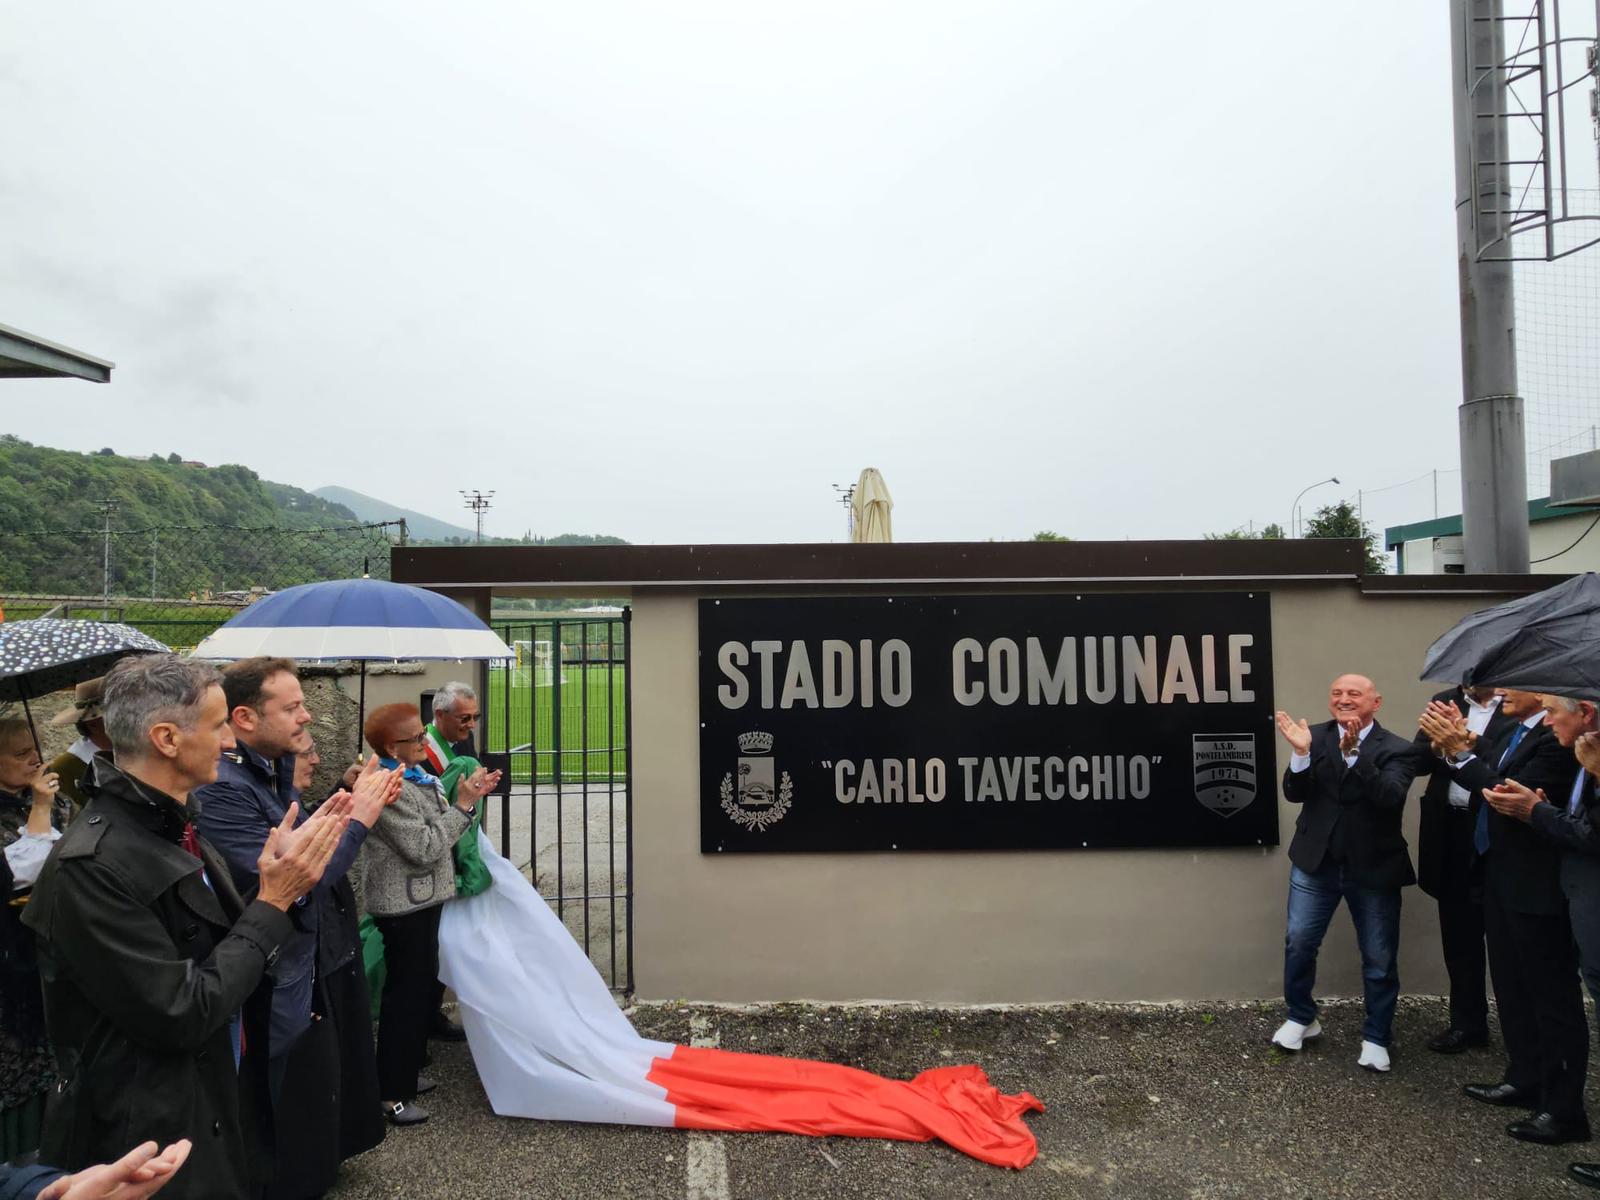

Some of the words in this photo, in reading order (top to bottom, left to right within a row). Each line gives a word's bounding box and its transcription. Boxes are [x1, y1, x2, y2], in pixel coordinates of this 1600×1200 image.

[717, 638, 912, 710] STADIO
[952, 634, 1256, 707] COMUNALE
[1213, 742, 1236, 751] A.S.D.
[1195, 751, 1253, 760] PONTELAMBRESE
[1211, 768, 1239, 780] 1974
